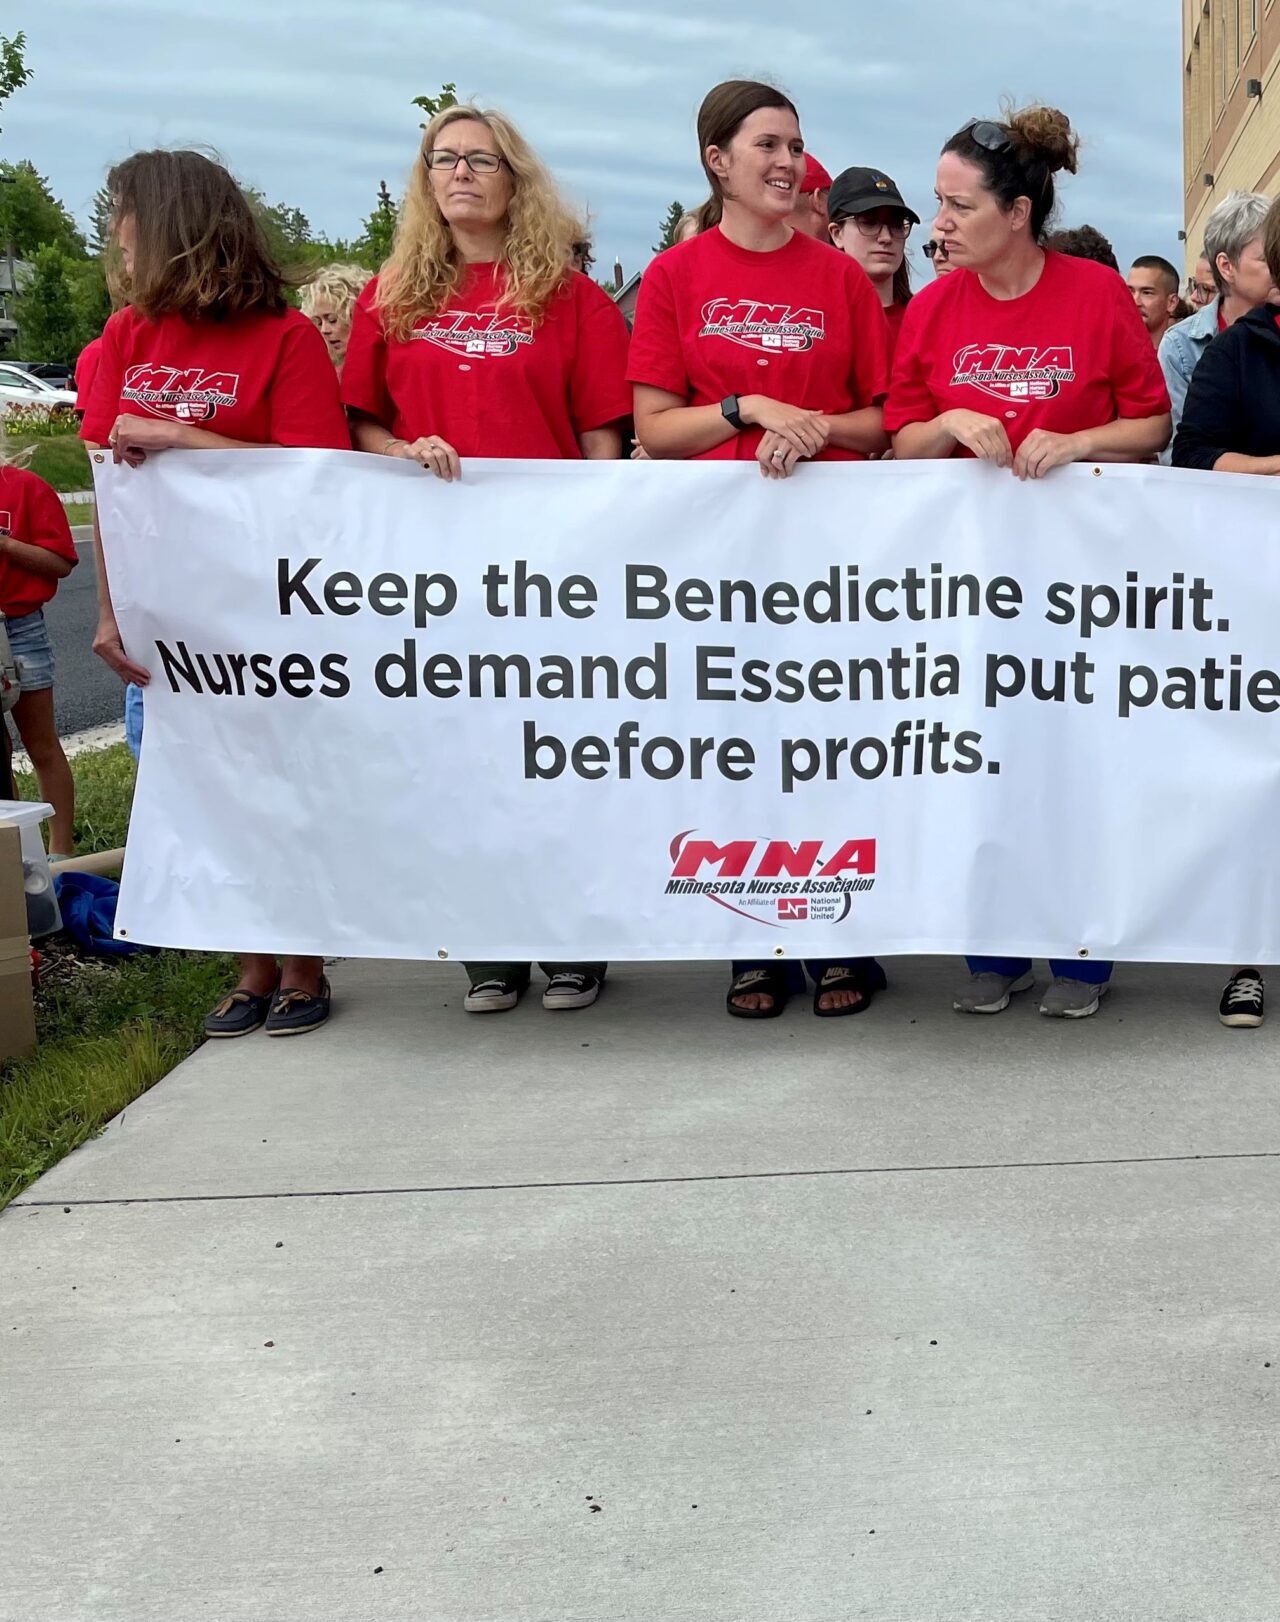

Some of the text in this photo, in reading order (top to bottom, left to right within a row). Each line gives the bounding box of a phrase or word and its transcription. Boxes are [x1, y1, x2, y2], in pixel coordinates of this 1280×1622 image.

[703, 304, 824, 332] MNA
[957, 347, 1073, 376] MNA
[124, 368, 239, 397] MNA
[278, 558, 1229, 638] Keep the Benedictine spirit.
[155, 639, 351, 699] Nurses
[374, 638, 667, 700] demand
[696, 642, 960, 702] Essentia
[985, 651, 1095, 707] put
[523, 719, 1000, 792] before profits.
[671, 838, 876, 877] MNA
[665, 878, 875, 894] Minnesota Nurses Association
